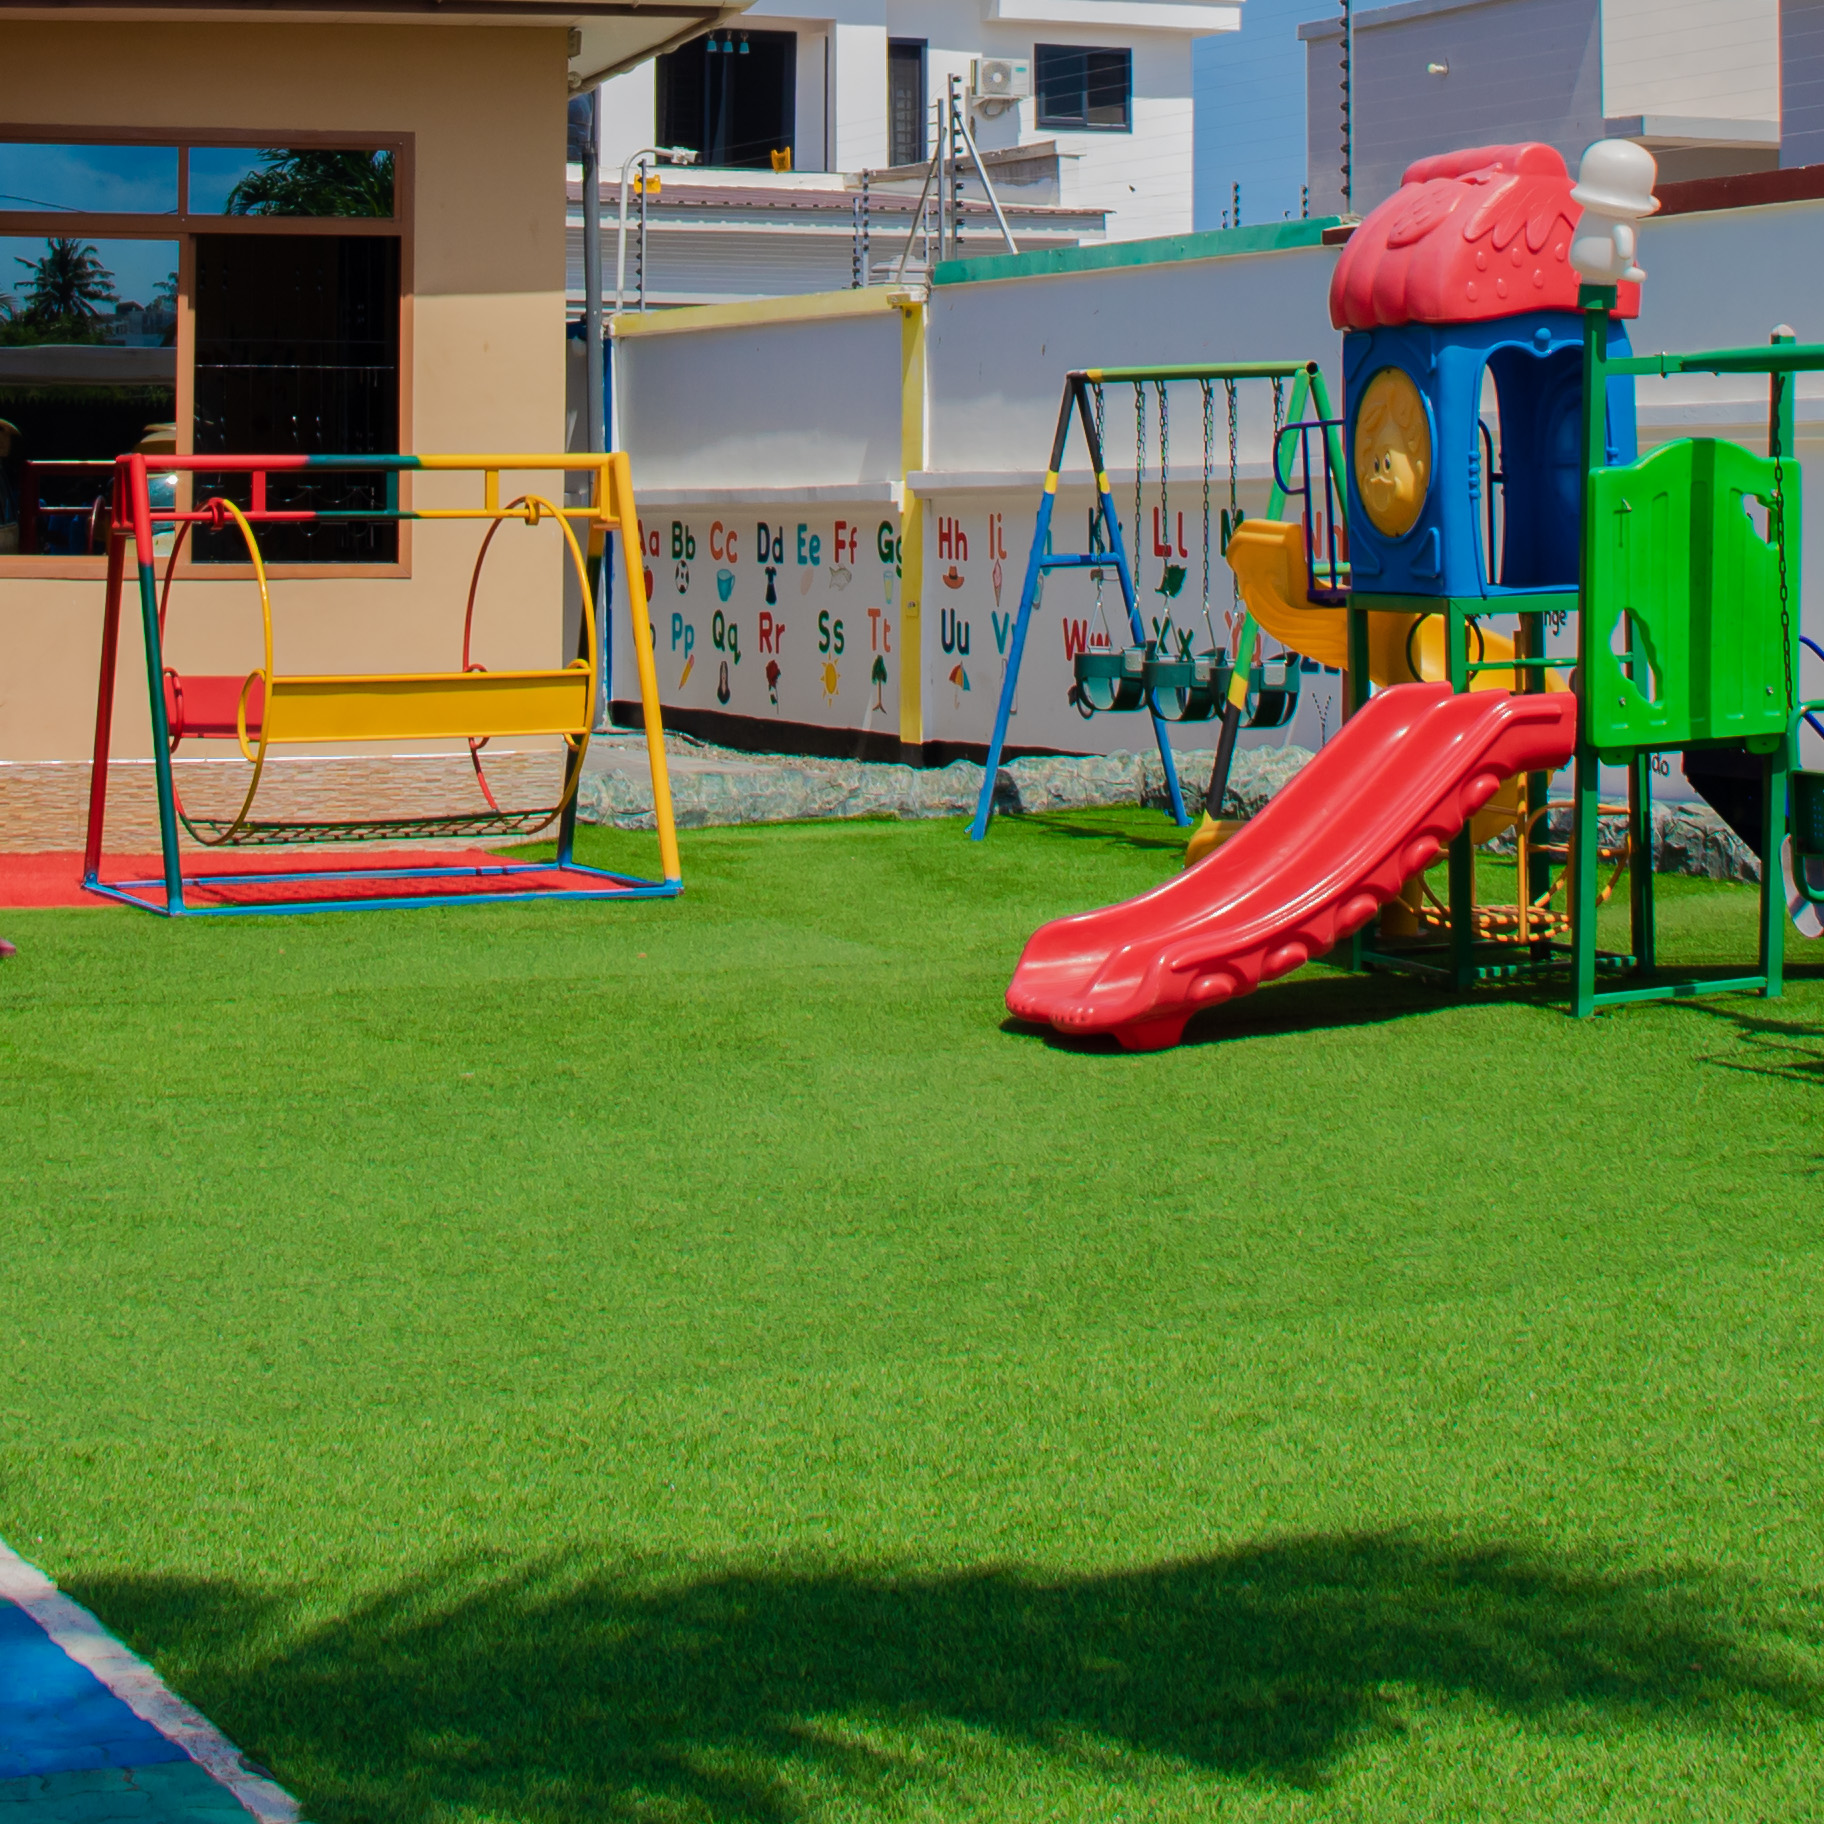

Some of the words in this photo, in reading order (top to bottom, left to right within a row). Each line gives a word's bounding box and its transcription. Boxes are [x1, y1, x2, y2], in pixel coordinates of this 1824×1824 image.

[671, 520, 696, 560] Bb
[710, 521, 738, 563] Cc
[757, 522, 784, 564] Dd
[797, 524, 821, 565] Ee
[834, 521, 858, 564] Ff
[939, 516, 968, 561] Hh
[989, 513, 1007, 559] Ii
[671, 612, 694, 659] Pp
[712, 609, 741, 665] Qq
[758, 611, 785, 654] Rr
[818, 610, 845, 654] Ss
[867, 608, 891, 653] Tt
[941, 608, 970, 655] Uu
